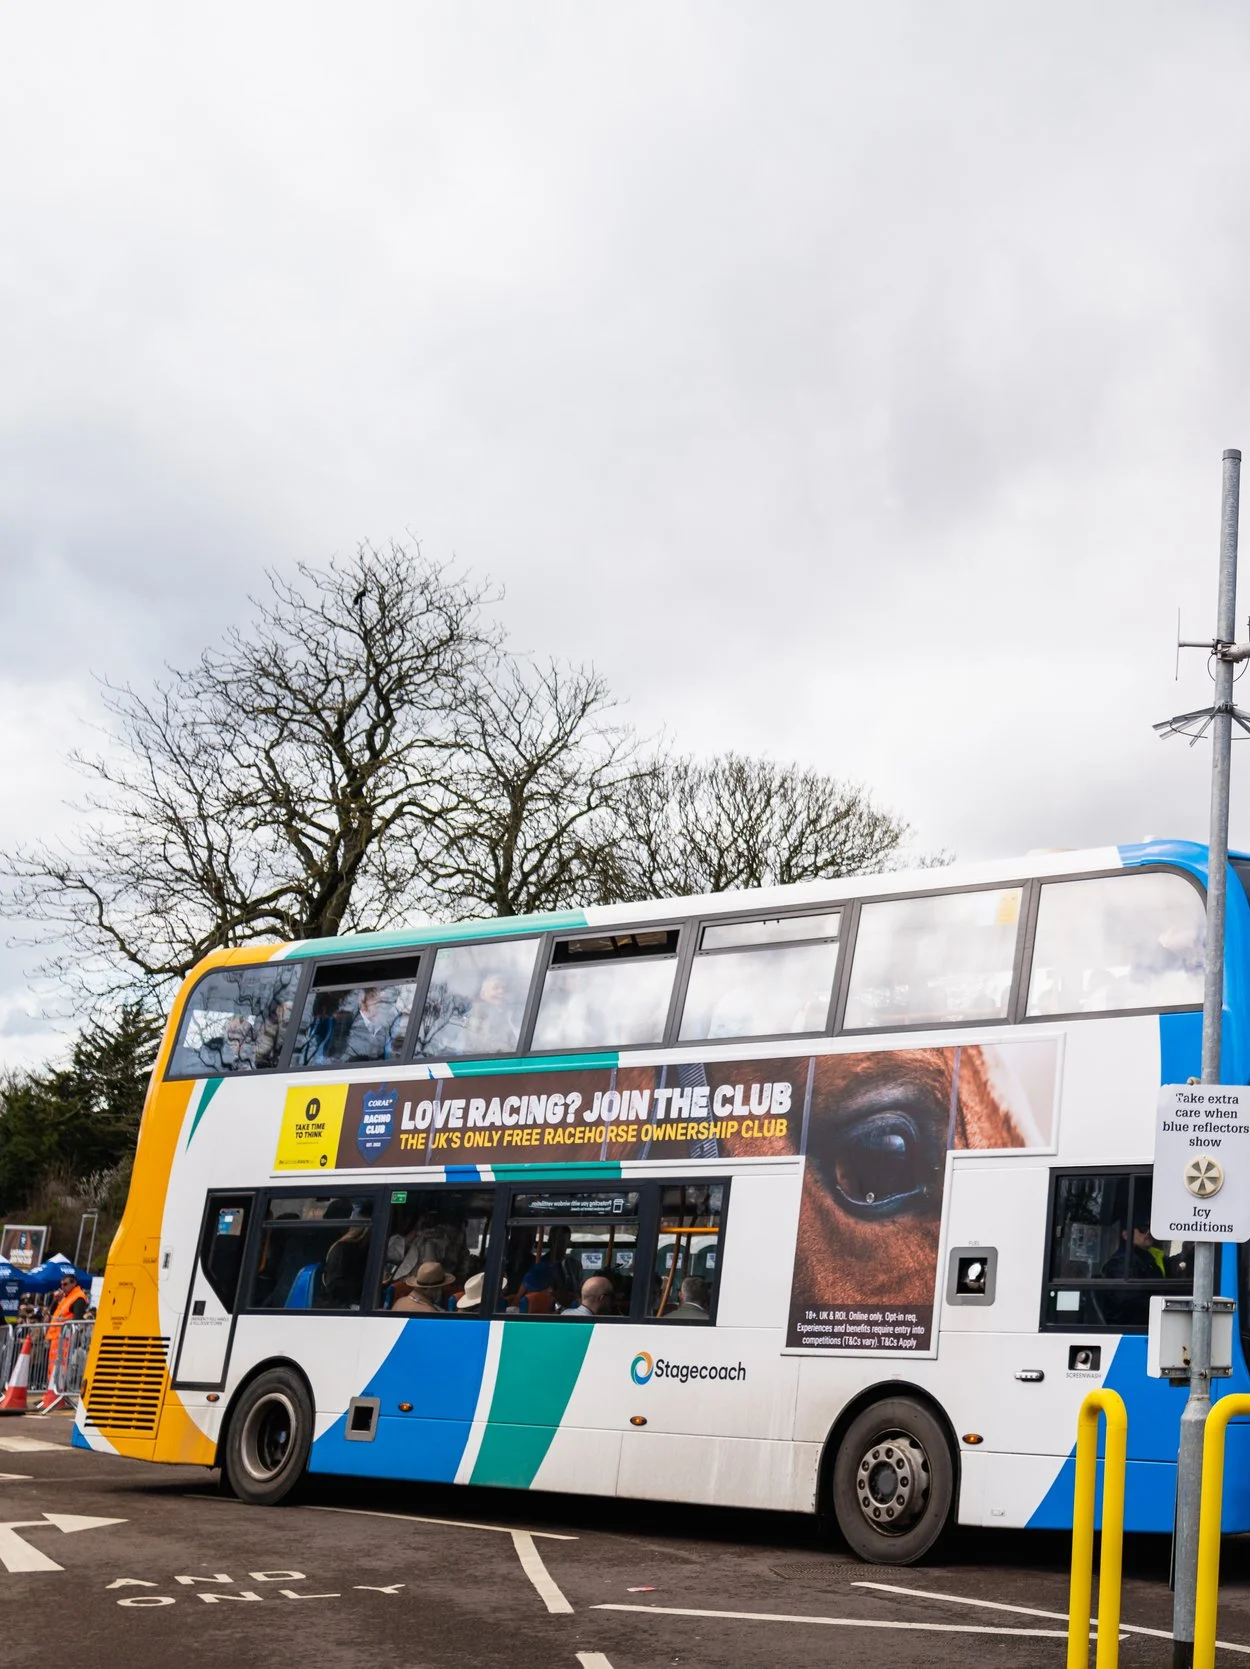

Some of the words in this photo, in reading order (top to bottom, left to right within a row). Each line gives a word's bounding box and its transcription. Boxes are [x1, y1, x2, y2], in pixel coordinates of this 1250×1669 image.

[368, 1099, 389, 1107] CORAL
[400, 1099, 467, 1130] LOVE
[467, 1091, 582, 1128] RACING?
[583, 1089, 650, 1123] JOIN
[653, 1086, 710, 1119] THE
[712, 1081, 792, 1117] CLUB
[1175, 1093, 1205, 1105] Take
[1207, 1094, 1239, 1105] extra
[363, 1113, 391, 1124] RACING
[1175, 1108, 1201, 1118] care
[1204, 1108, 1238, 1119] when
[295, 1123, 310, 1131] TAKE
[311, 1122, 326, 1130] TIME
[365, 1124, 386, 1135] CLUB
[1162, 1121, 1189, 1132] blue
[1192, 1122, 1250, 1134] reflectors
[295, 1131, 303, 1139] TO
[304, 1130, 322, 1139] THINK
[400, 1133, 427, 1150] THE
[463, 1130, 502, 1148] ONLY
[503, 1128, 541, 1147] FREE
[543, 1124, 638, 1145] RACEHORSE
[641, 1120, 739, 1141] OWNERSHIP
[741, 1118, 788, 1139] CLUB
[1189, 1136, 1222, 1148] show
[1192, 1206, 1212, 1219] Icy
[1169, 1221, 1234, 1233] conditions
[805, 1310, 818, 1320] 18+.
[819, 1311, 828, 1320] UK
[829, 1312, 834, 1320] &
[848, 1311, 868, 1321] Online
[869, 1312, 884, 1323] only.
[885, 1312, 904, 1323] Opt-in
[905, 1313, 918, 1323] req.
[797, 1322, 832, 1334] Experiences
[833, 1323, 846, 1333] and
[846, 1323, 871, 1334] benefits
[871, 1325, 894, 1335] require
[894, 1326, 911, 1337] entry
[911, 1325, 925, 1335] into
[802, 1335, 841, 1347] competitions
[842, 1335, 861, 1347] (T&Cs
[862, 1337, 880, 1348] vary).
[881, 1337, 898, 1347] T&Cs
[898, 1337, 917, 1349] Apply
[654, 1358, 746, 1383] Stagecoach
[105, 1570, 307, 1589] AND
[116, 1583, 406, 1607] ONLY
